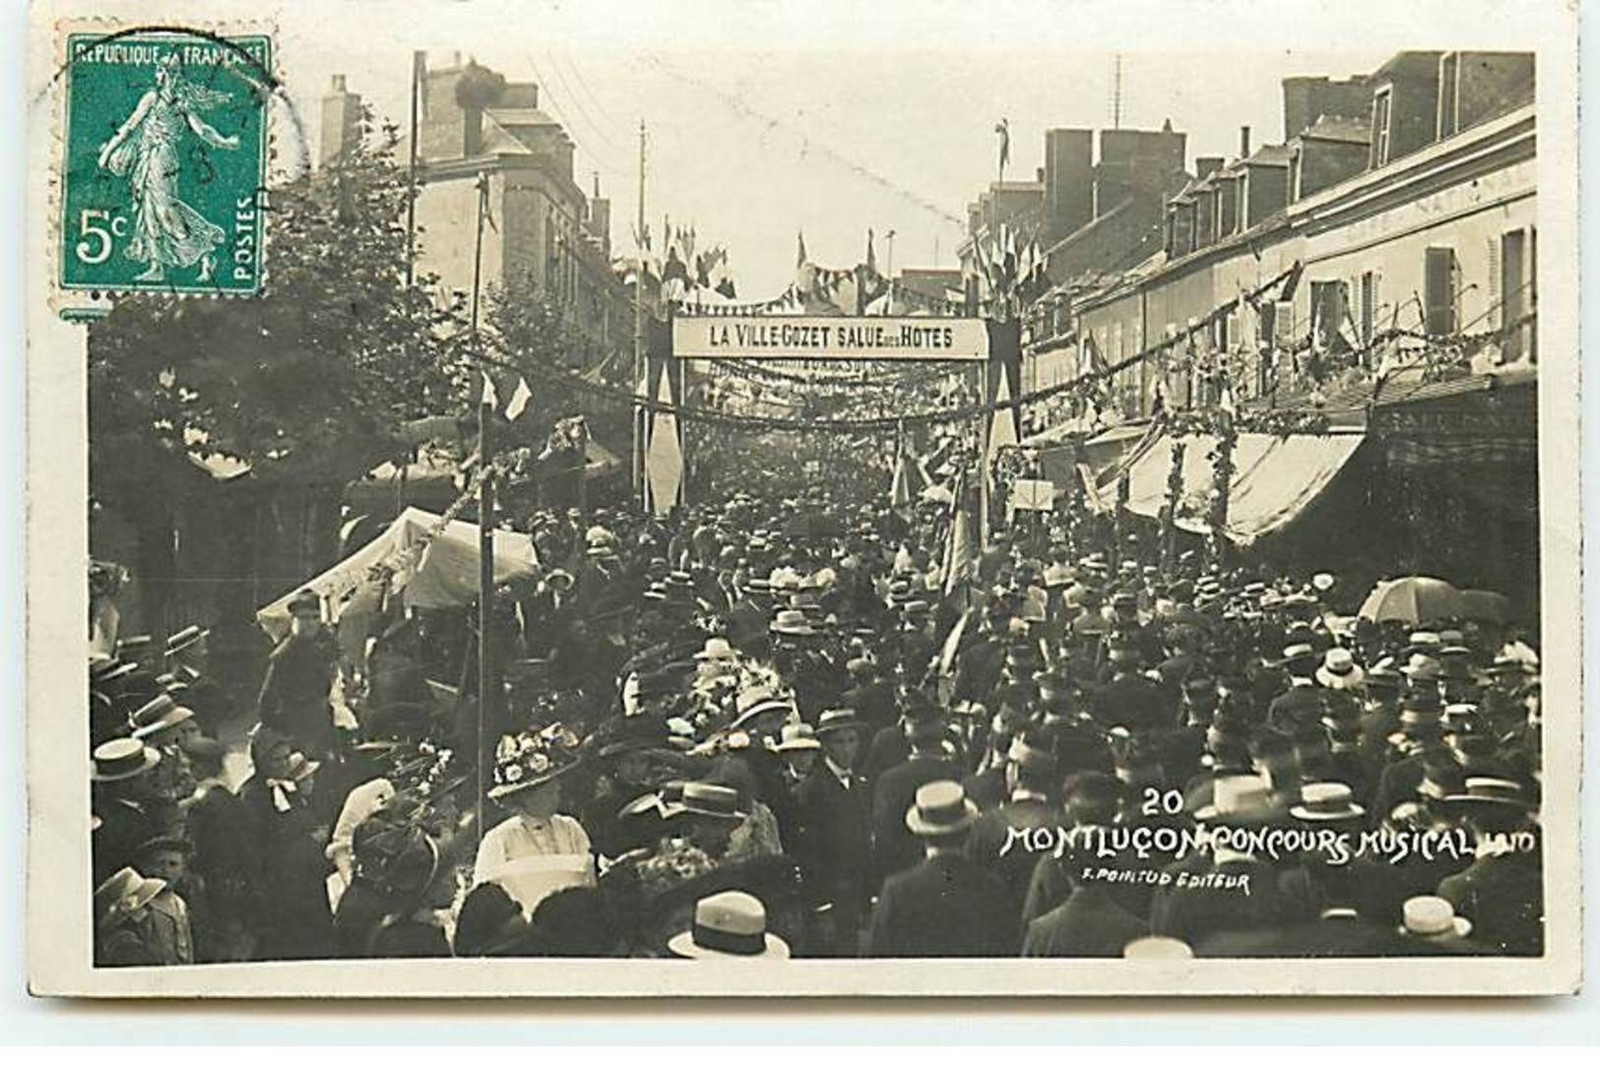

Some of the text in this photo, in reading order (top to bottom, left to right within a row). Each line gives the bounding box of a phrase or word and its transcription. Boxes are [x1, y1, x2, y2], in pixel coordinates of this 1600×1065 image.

[234, 196, 254, 280] POSTES
[710, 326, 730, 346] LA
[838, 327, 883, 347] SALUE
